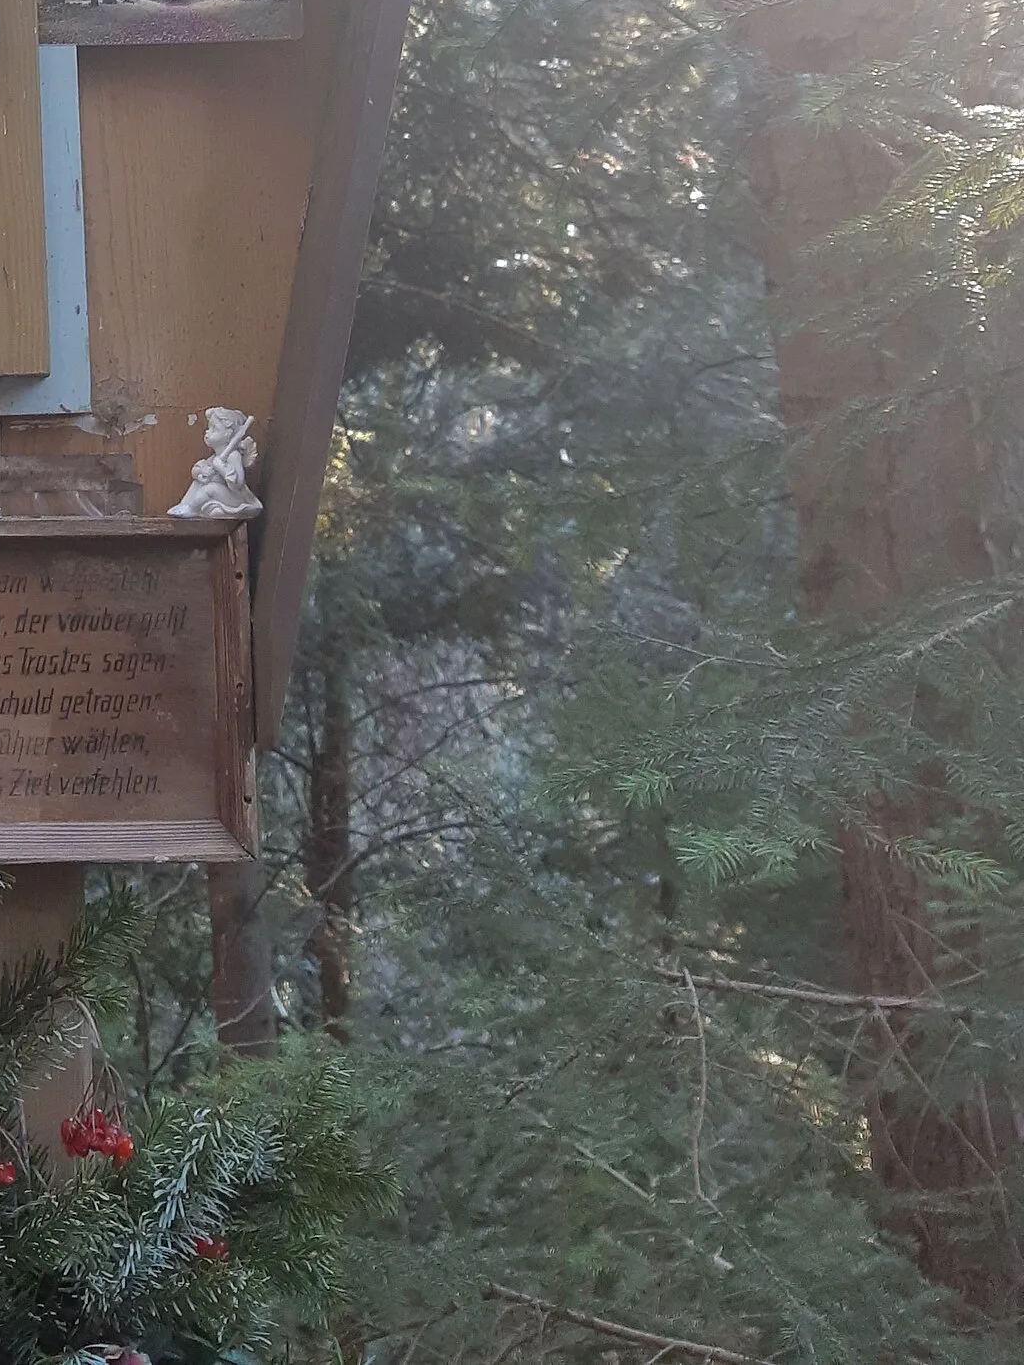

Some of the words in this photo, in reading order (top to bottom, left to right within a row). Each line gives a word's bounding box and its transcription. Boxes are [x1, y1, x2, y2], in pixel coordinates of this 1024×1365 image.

[15, 607, 53, 634] der
[19, 646, 92, 676] Trostes
[8, 767, 52, 797] Ziel
[58, 765, 163, 801] verfehlen.
